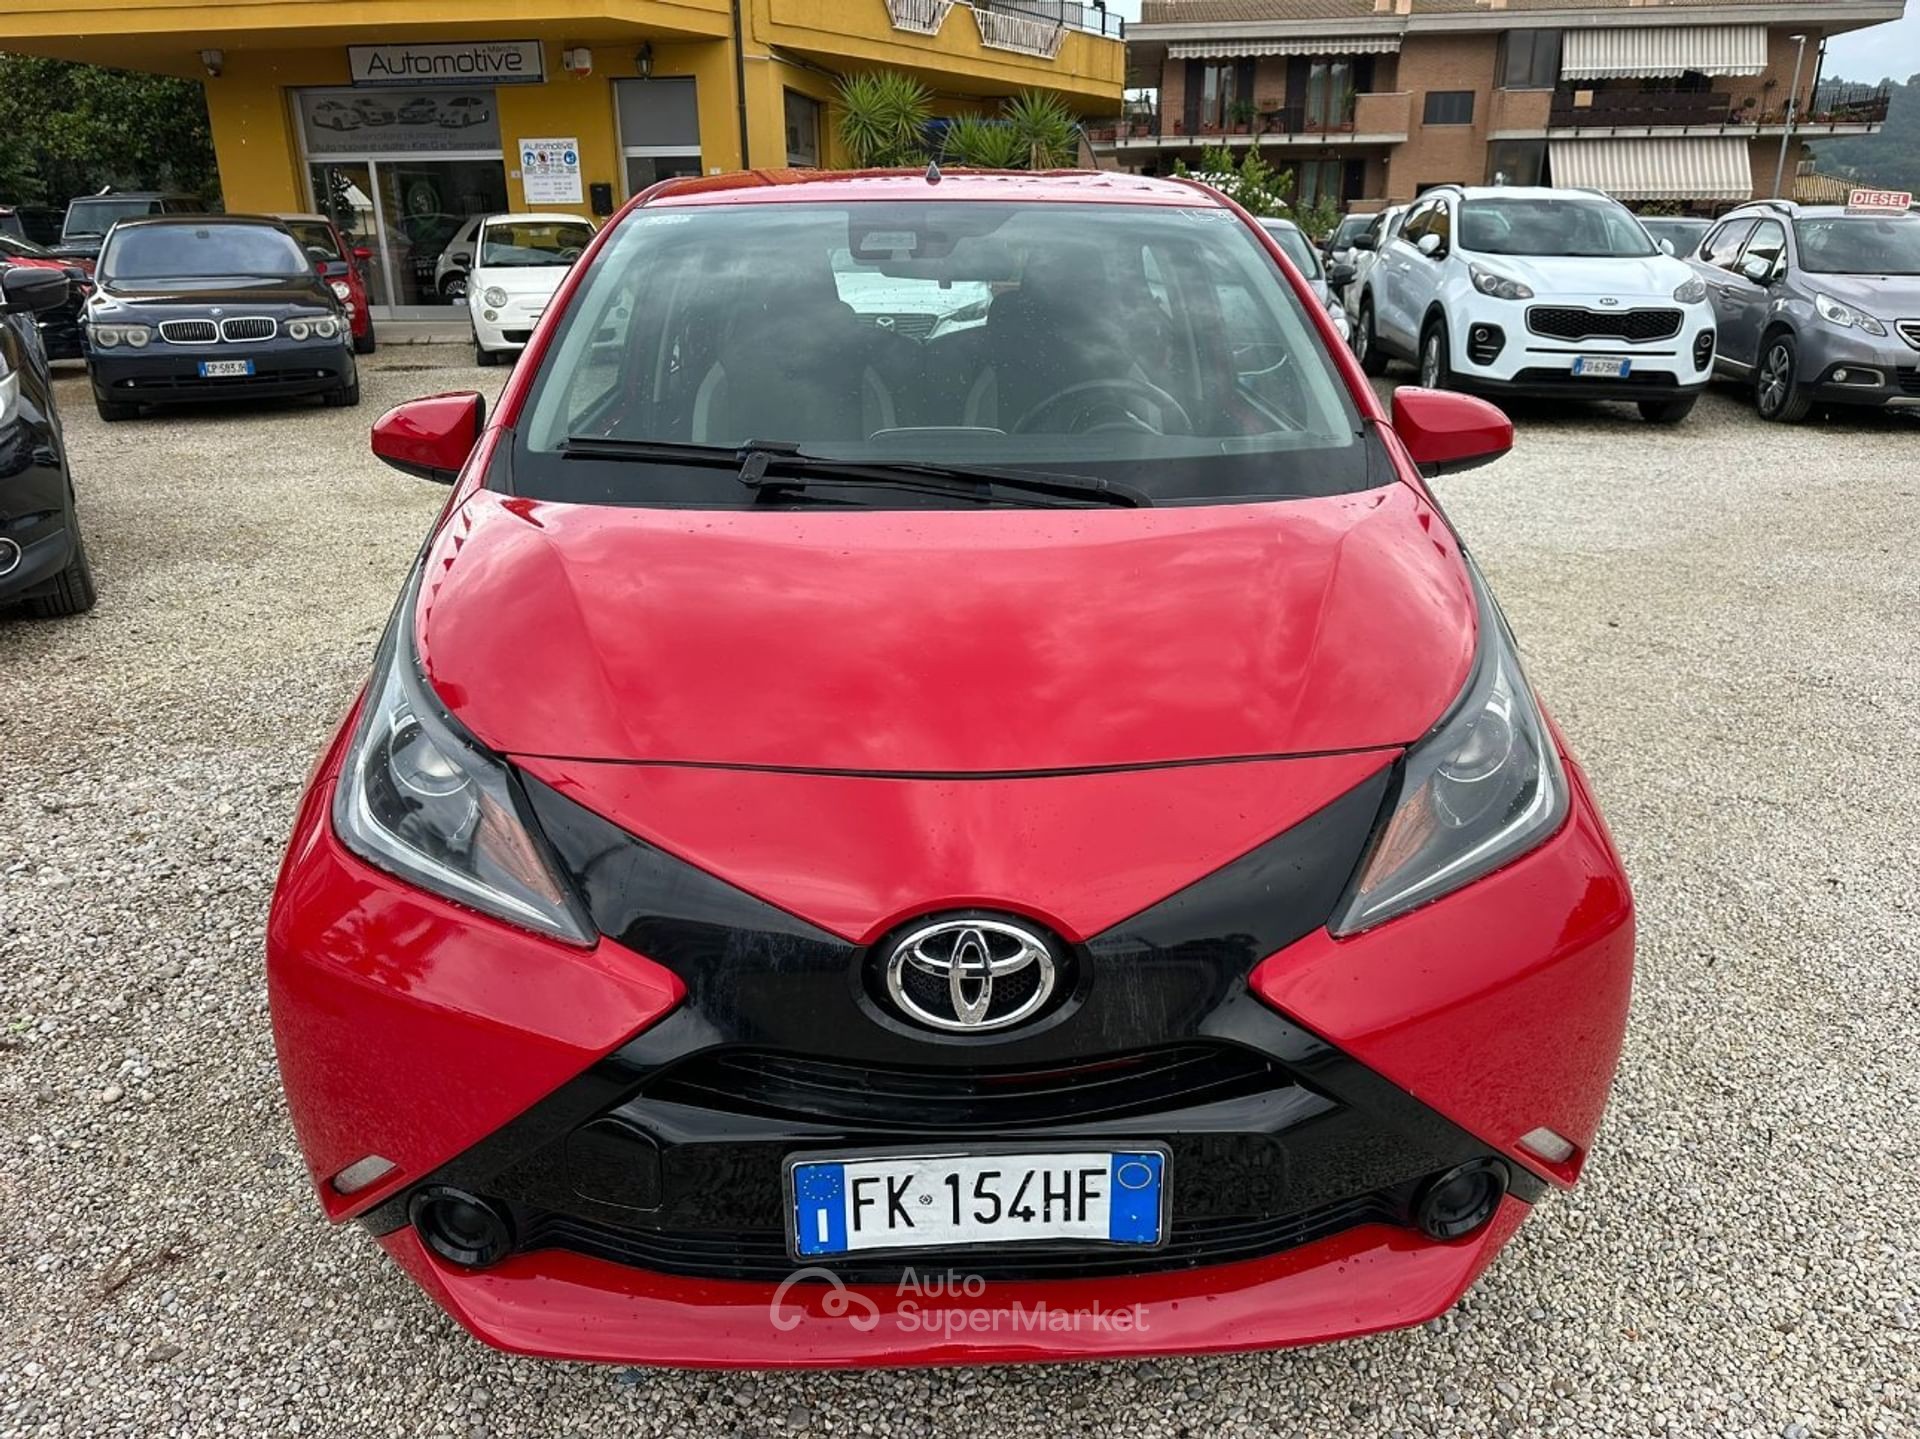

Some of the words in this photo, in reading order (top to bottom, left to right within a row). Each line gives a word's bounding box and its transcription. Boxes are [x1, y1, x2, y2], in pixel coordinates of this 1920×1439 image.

[367, 48, 522, 75] Automotive
[523, 142, 574, 151] Automotive
[1852, 192, 1907, 207] DIESEL
[851, 1173, 916, 1232] FK
[944, 1168, 1108, 1226] 154HF
